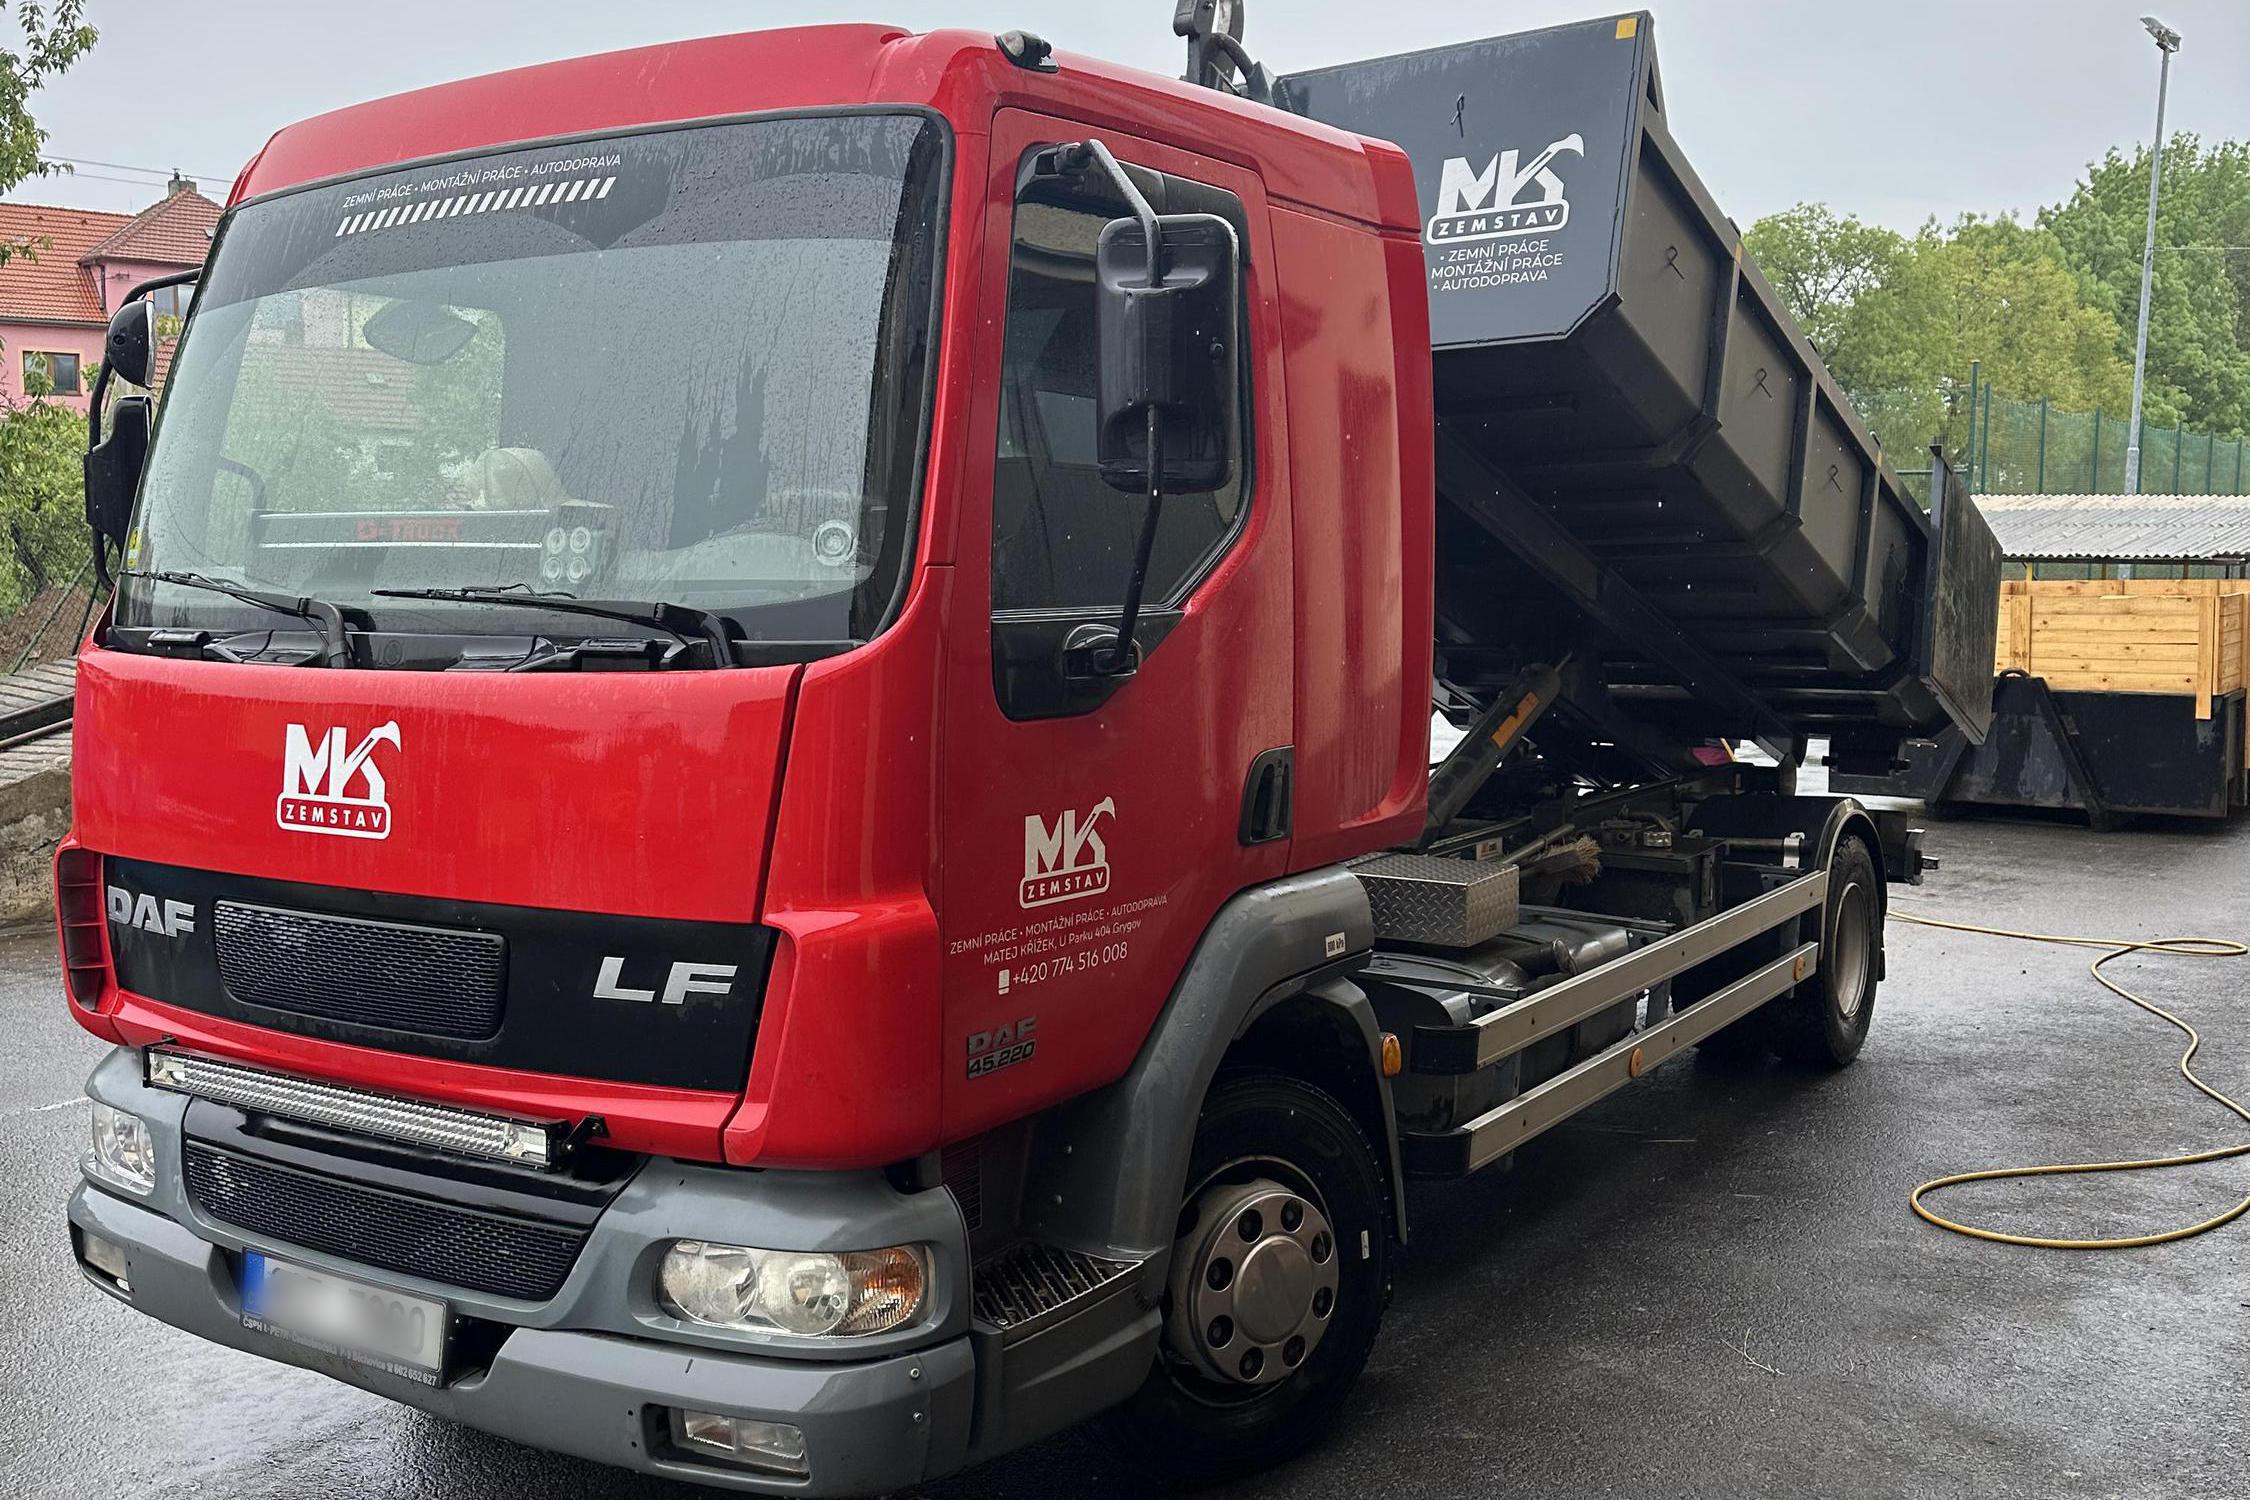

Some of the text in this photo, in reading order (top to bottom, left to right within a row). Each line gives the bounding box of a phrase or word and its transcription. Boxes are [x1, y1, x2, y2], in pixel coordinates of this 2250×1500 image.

[343, 154, 621, 208] ZEMNÍ PRÁCE MONTÁŽNÍ PRÁCE AUTODOPRAVA
[1438, 209, 1558, 236] ZEMSTAV
[1431, 253, 1563, 279] MONTÁŽNÍ PRÁCE
[1448, 239, 1549, 262] ZEMNÍ PRÁCE
[1441, 270, 1548, 291] AUTODOPRAVA
[285, 803, 384, 828] ZEMSTAV
[1027, 871, 1104, 899] ZEMSTAV
[107, 884, 197, 939] DAF
[950, 895, 1168, 955] ZEMNÍ PRÁCE MONTÁŽNÍ PRÁCE AUTODOPRAVA
[1060, 935, 1067, 947] U
[1069, 930, 1093, 944] Parku
[1112, 919, 1142, 934] Grygov
[1013, 941, 1128, 986] +420 774 516 008
[592, 956, 738, 1004] LF
[968, 1016, 1037, 1056] DAF
[969, 1041, 1036, 1077] 45.220
